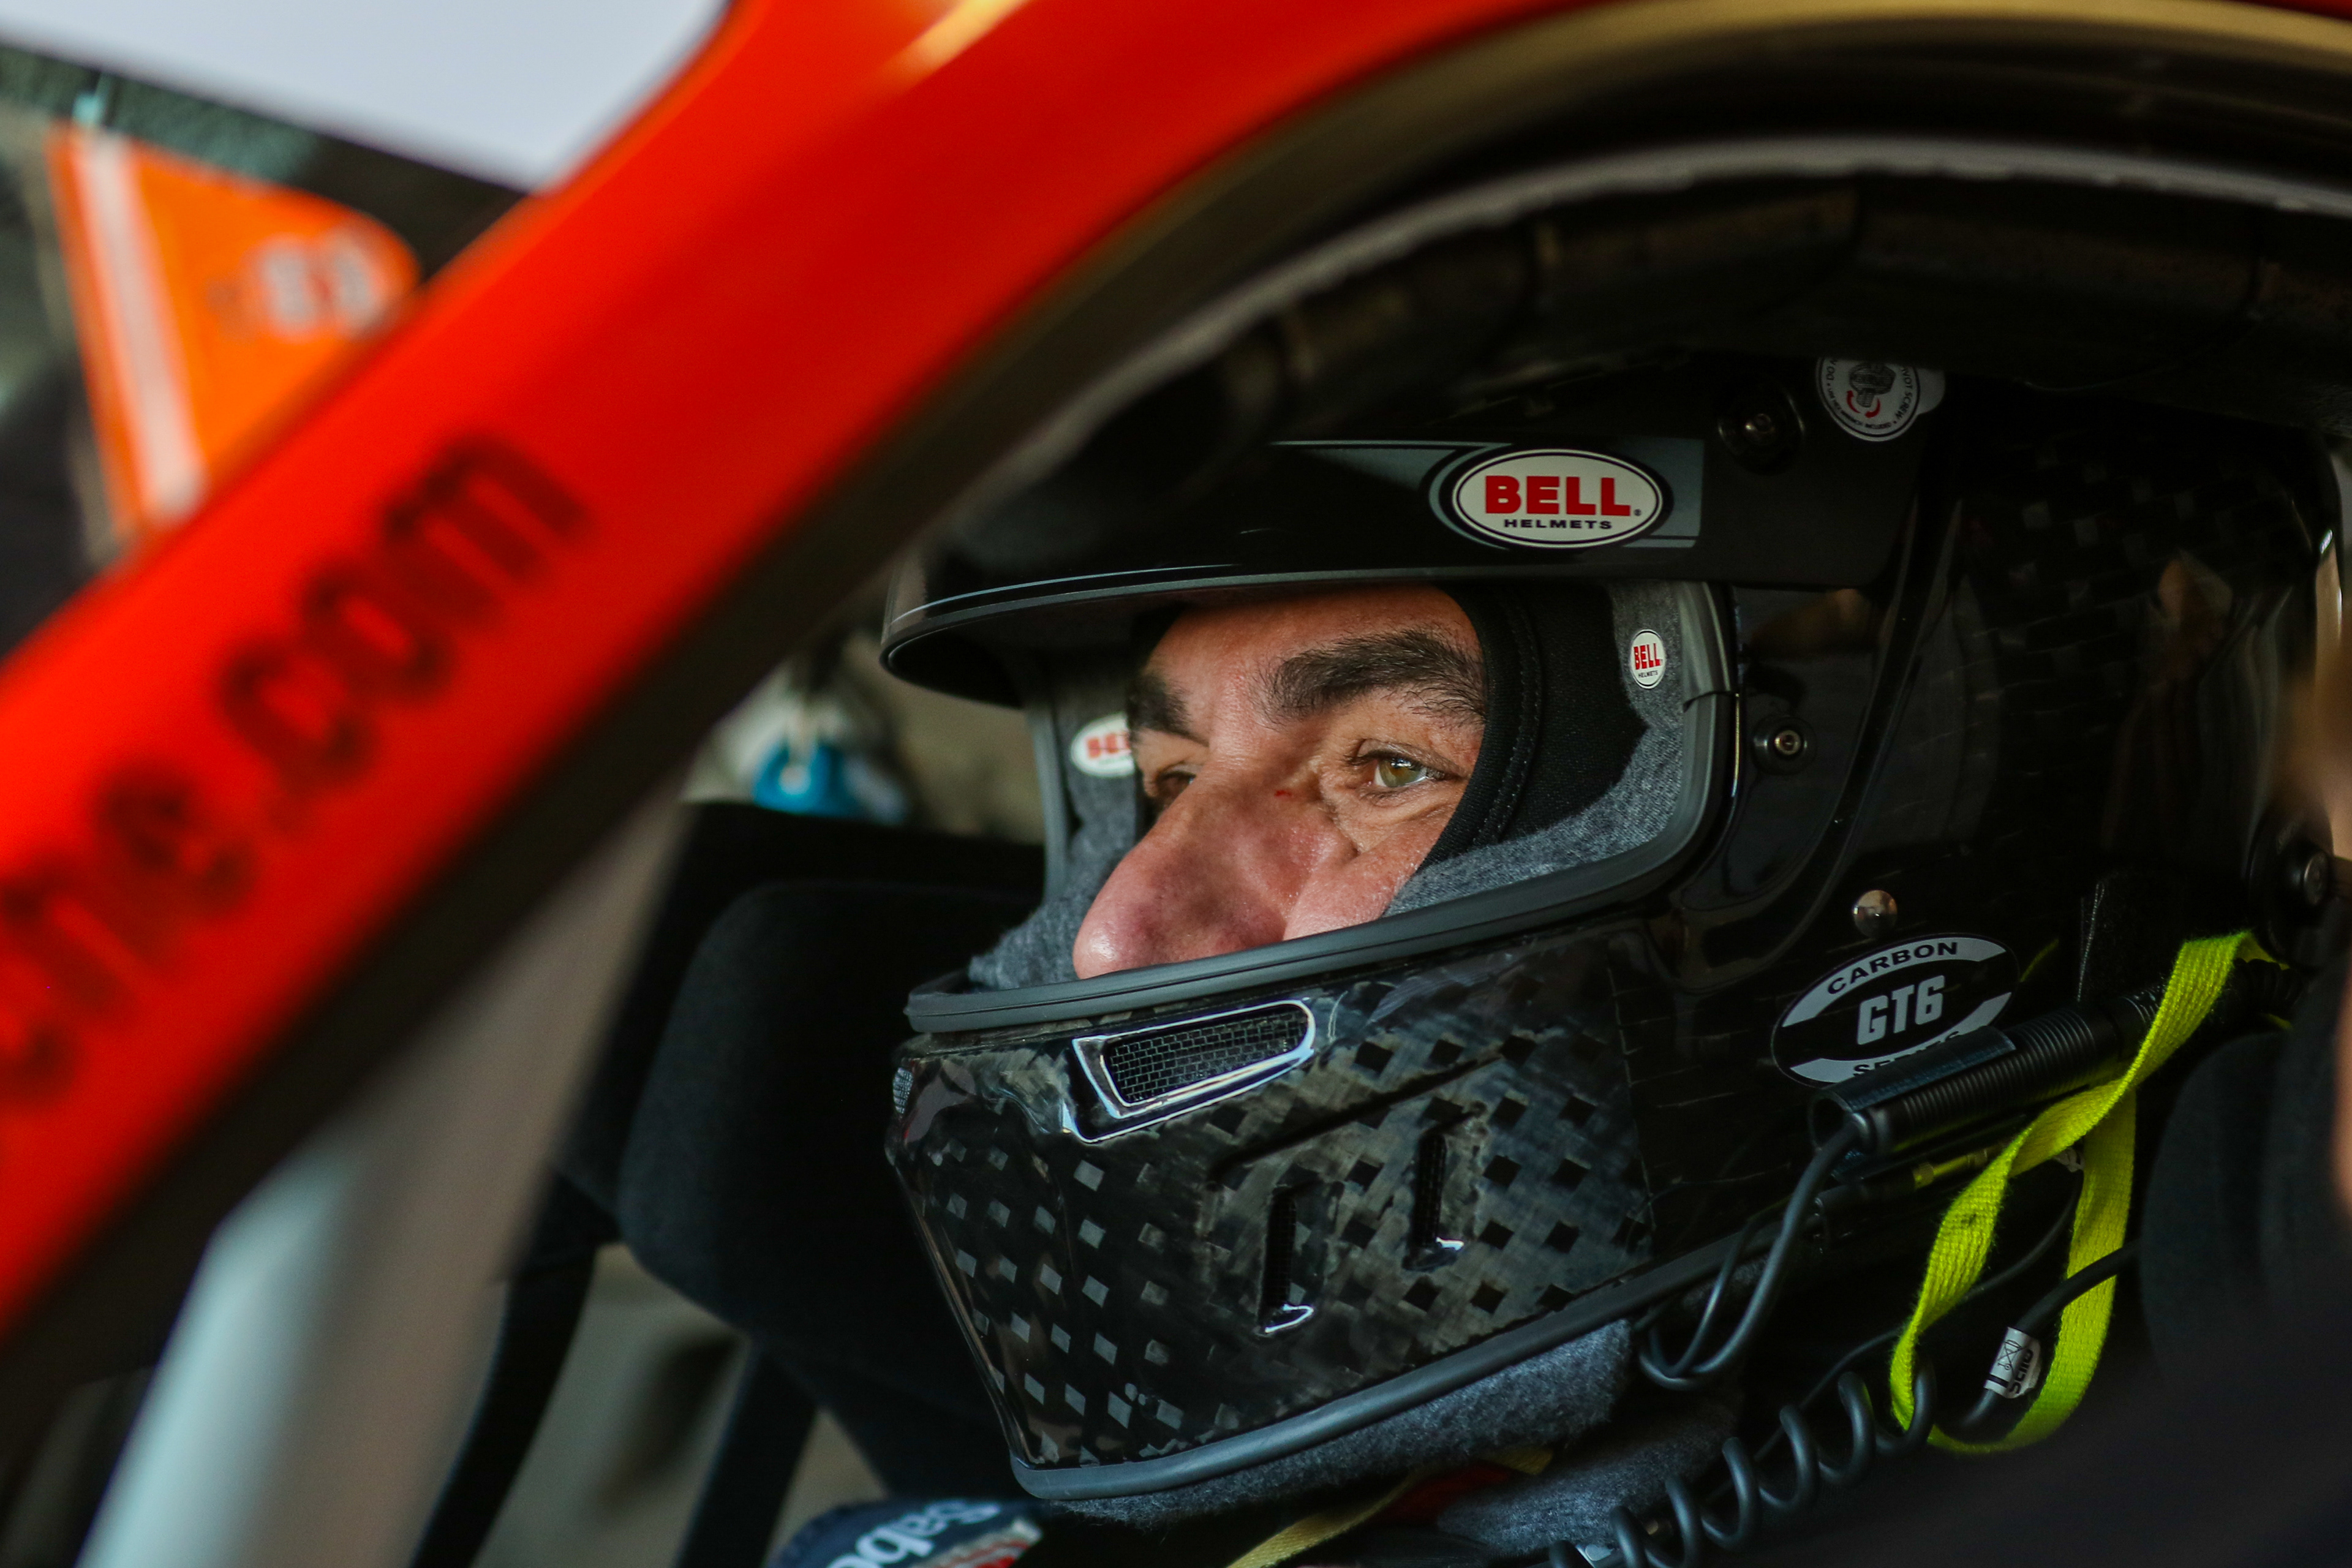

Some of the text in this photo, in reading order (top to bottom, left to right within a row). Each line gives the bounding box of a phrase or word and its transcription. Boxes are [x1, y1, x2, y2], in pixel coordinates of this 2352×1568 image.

[1895, 391, 1913, 420] SCREW
[1485, 475, 1631, 516] BELL
[1504, 519, 1613, 529] HELMETS
[1633, 643, 1661, 670] BELL
[1828, 942, 1958, 995] CARBON
[1857, 974, 1945, 1046] GT6
